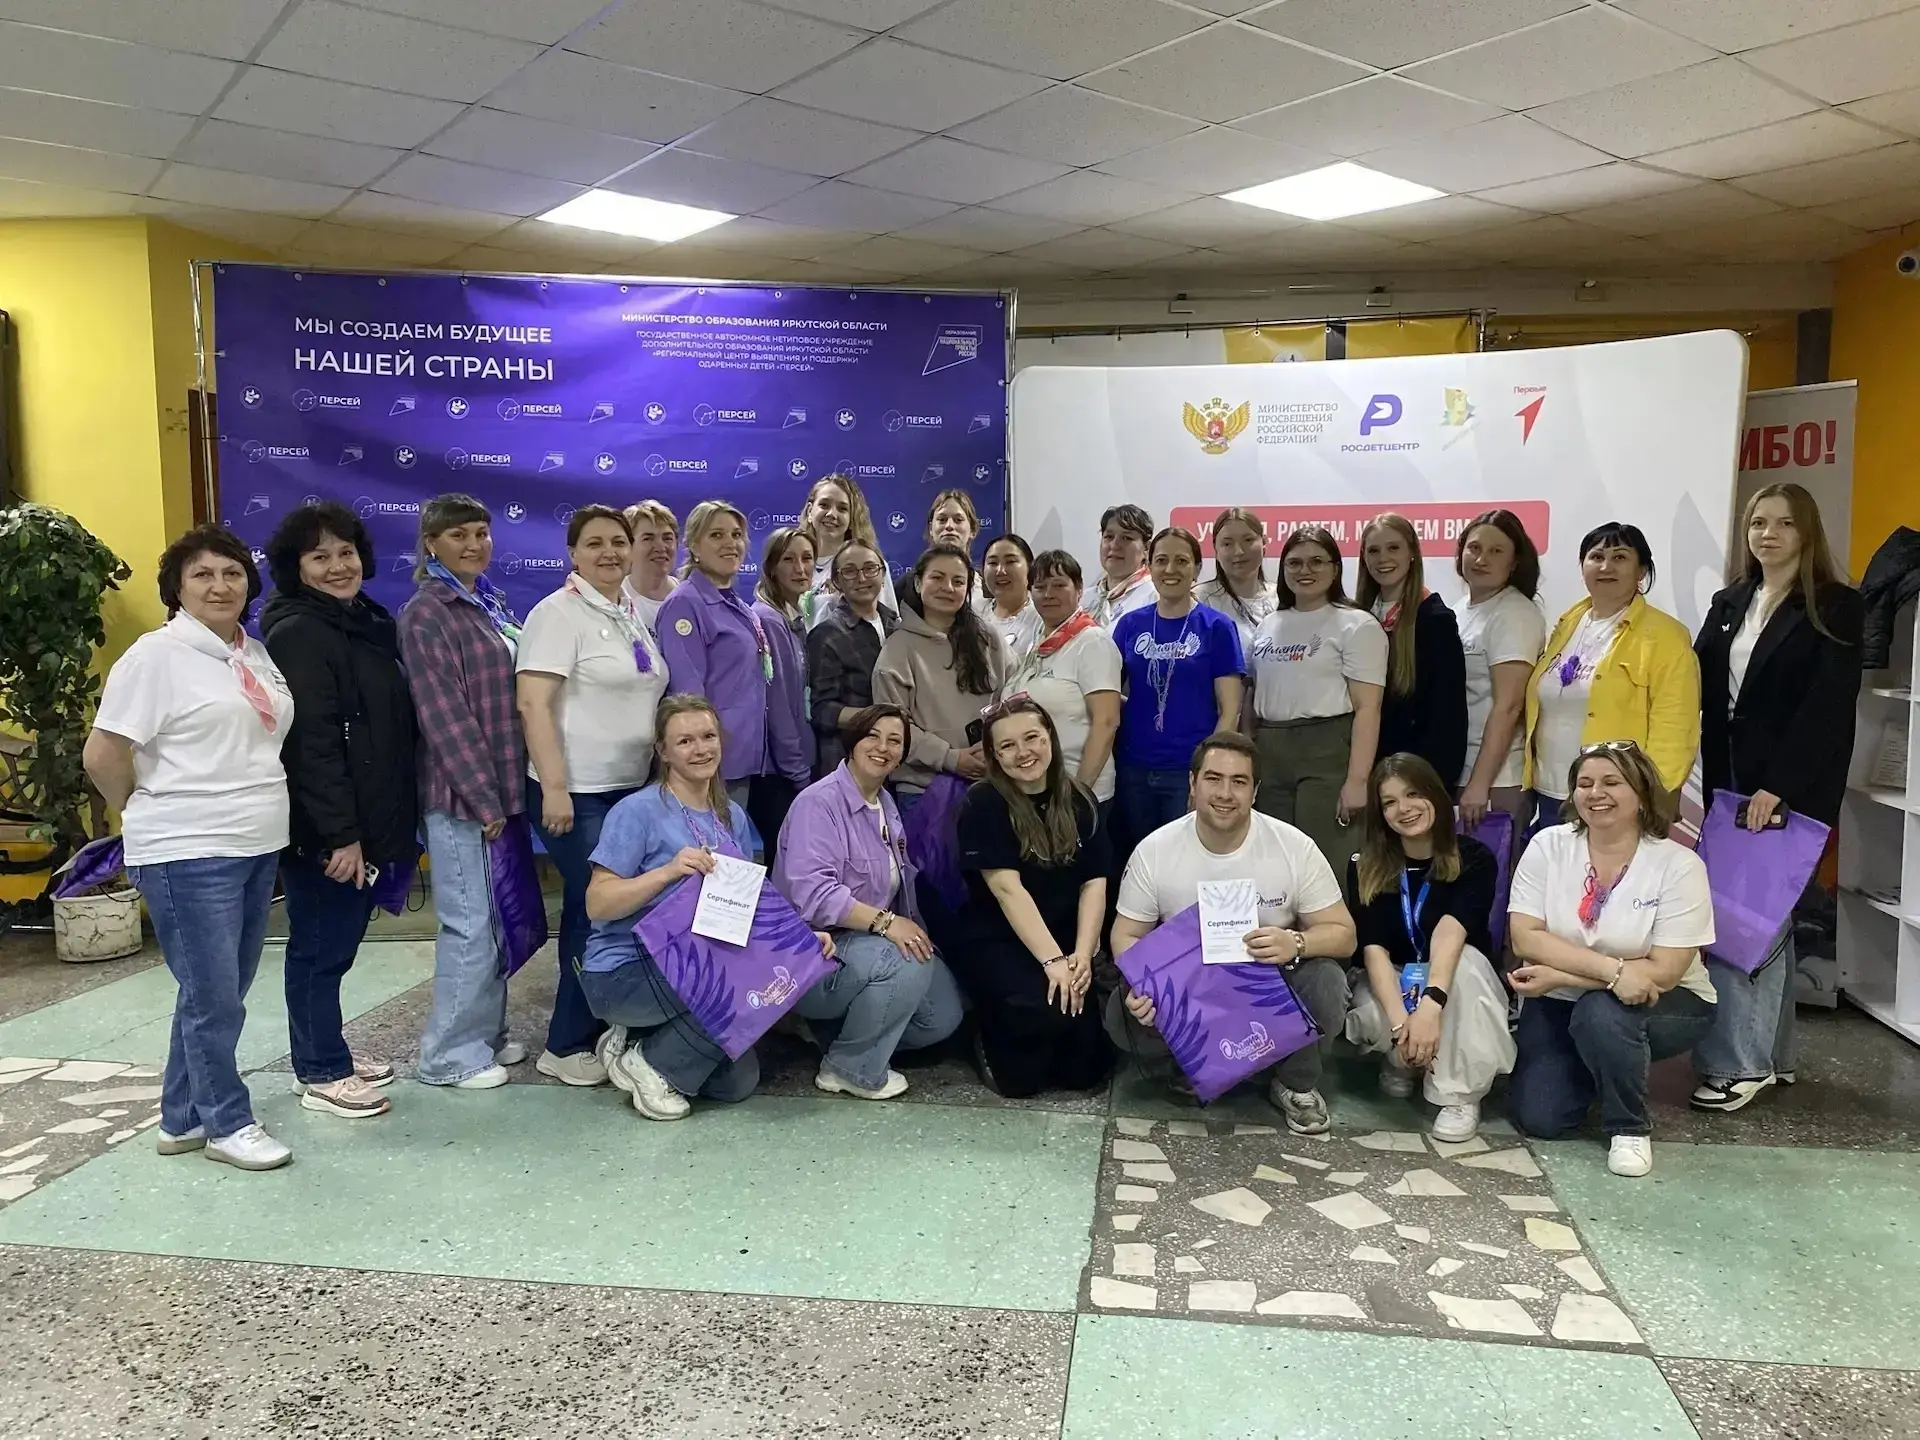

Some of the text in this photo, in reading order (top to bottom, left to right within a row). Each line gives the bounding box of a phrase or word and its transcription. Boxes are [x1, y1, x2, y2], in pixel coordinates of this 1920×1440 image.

[622, 313, 887, 331] МИНИСТЕРСТВО ОБРАЗОВАНИЯ ИРКУТСКОЙ ОБЛАСТИ
[295, 317, 552, 345] МЫ СОЗДАЕМ БУДУЩЕЕ
[636, 330, 873, 346] ГОСУДАРСТВЕННОЕ АВТОНОМНОЕ НЕТИПОВОЕ УЧРЕЖДЕНИЕ
[641, 340, 869, 355] ДОПОЛНИТЕЛЬНОГО ОБРАЗОВАНИЯ ИРКУТСКОЙ ОБЛАСТИ
[723, 352, 750, 361] ЦЕНТР
[751, 353, 800, 361] ВЫЯВЛЕНИЯ
[809, 356, 859, 364] ПОДДЕРЖКИ
[294, 348, 554, 381] НАШЕЙ СТРАНЫ
[698, 360, 748, 369] ОДАРЕННЫХ
[750, 361, 775, 371] ДЕТЕЙ
[1513, 385, 1547, 395] Первые
[319, 395, 361, 406] ПЕРСЕЙ
[523, 403, 562, 414] ПЕРСЕЙ
[1257, 402, 1339, 414] МИНИСТЕРСТВО
[717, 410, 756, 420] ПЕРСЕЙ
[906, 415, 943, 425] ПЕРСЕЙ
[1257, 413, 1333, 424] ПРОСВЕЩЕНИЯ
[1257, 423, 1323, 434] РОССИЙСКОЙ
[1256, 434, 1317, 445] ФЕДЕРАЦИИ
[268, 446, 310, 457] ПЕРСЕЙ
[1341, 442, 1420, 453] РОСДЕТЦЕНТР
[1739, 420, 1837, 472] ИБО!
[470, 453, 511, 464] ПЕРСЕЙ
[668, 459, 708, 470] ПЕРСЕЙ
[858, 465, 896, 475] ПЕРСЕЙ
[378, 502, 420, 512] ПЕРСЕЙ
[772, 514, 801, 523] ПЕРС
[524, 557, 564, 569] ПЕРСЕЙ
[739, 563, 758, 572] СЕЙ
[706, 892, 750, 910] Сертификат
[1207, 919, 1252, 928] Сертификат
